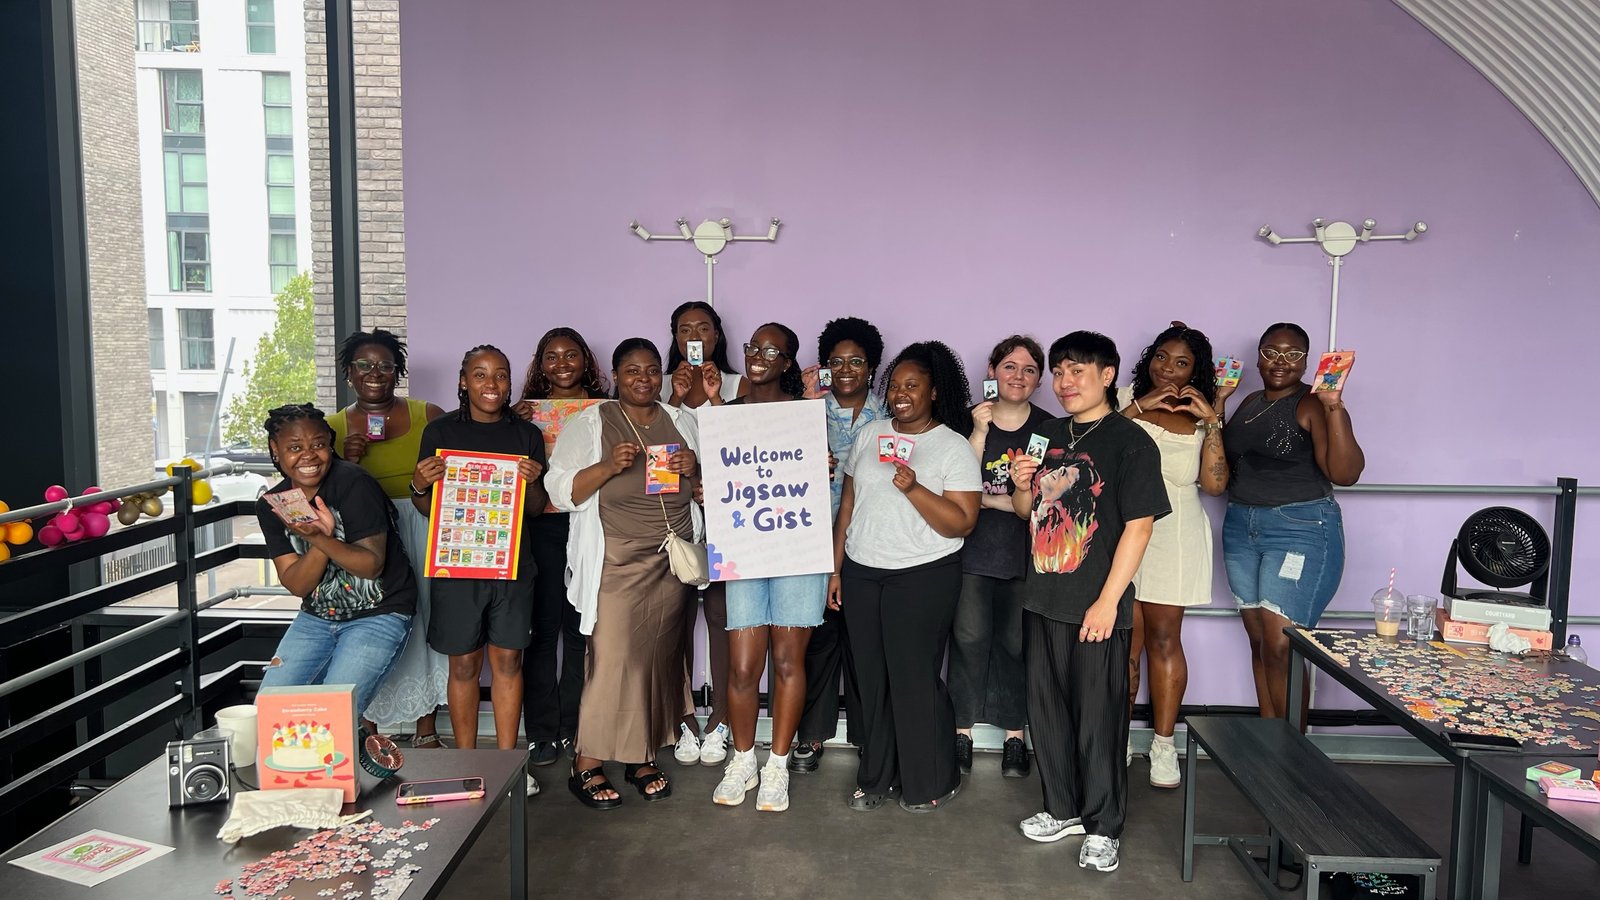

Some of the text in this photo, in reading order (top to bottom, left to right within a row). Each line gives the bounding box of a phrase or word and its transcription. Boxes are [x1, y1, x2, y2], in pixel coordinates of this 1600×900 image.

[720, 445, 804, 468] Welcome
[756, 465, 773, 479] to
[720, 480, 809, 509] Jigsaw
[731, 506, 813, 532] & Gist
[1485, 610, 1516, 619] COURTYARD
